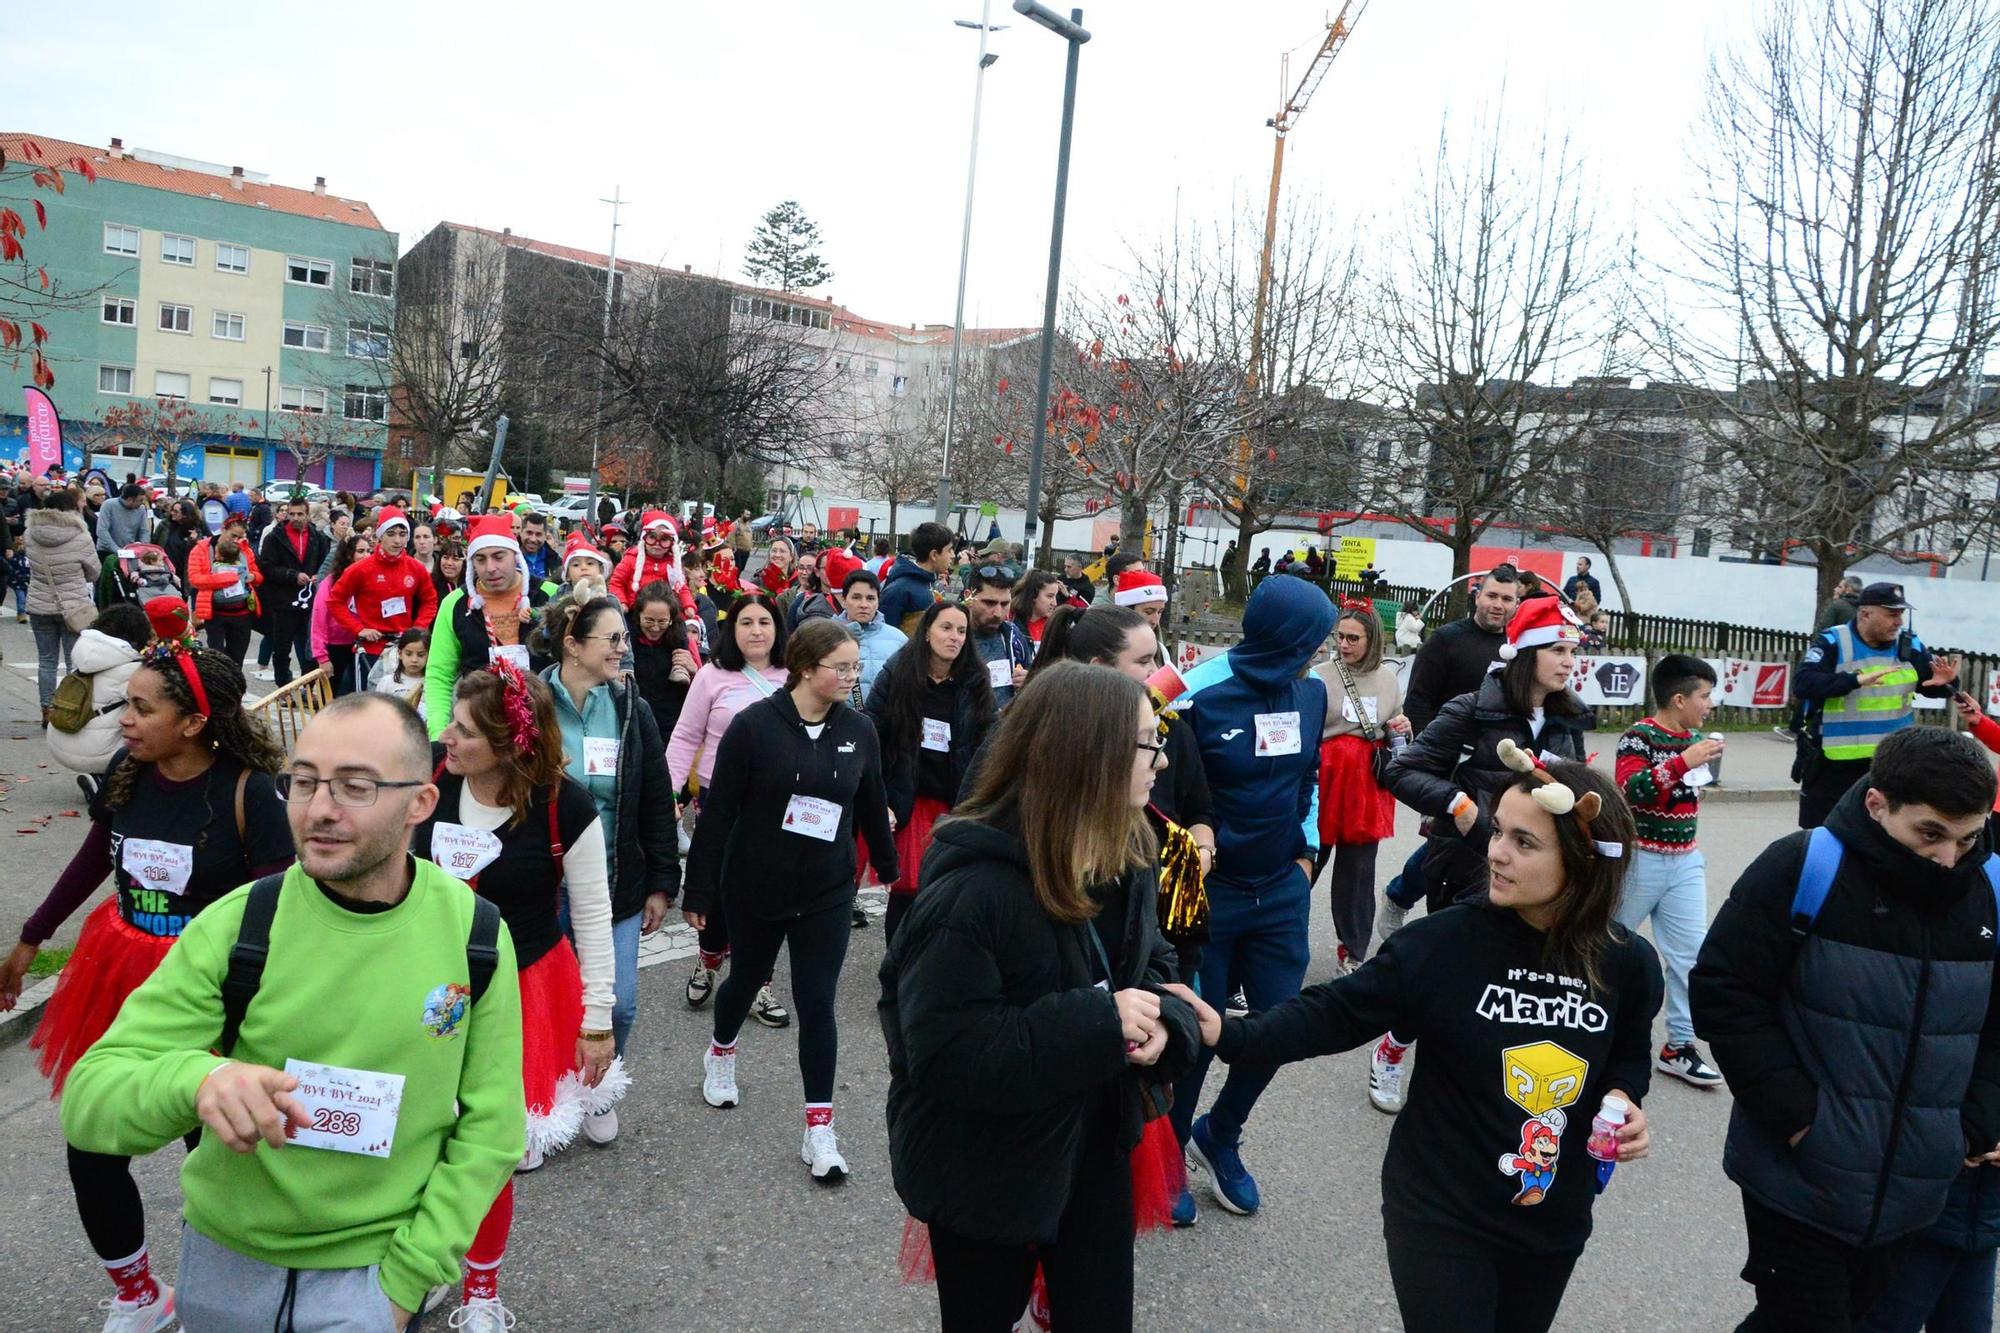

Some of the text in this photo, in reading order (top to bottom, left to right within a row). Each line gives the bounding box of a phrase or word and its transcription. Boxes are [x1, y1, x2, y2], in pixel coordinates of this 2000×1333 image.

[452, 851, 479, 869] 117
[129, 888, 169, 913] THE
[1558, 975, 1587, 990] me,
[1475, 984, 1609, 1033] Mario
[301, 1084, 381, 1107] BYE BYE 2024
[311, 1108, 361, 1136] 283
